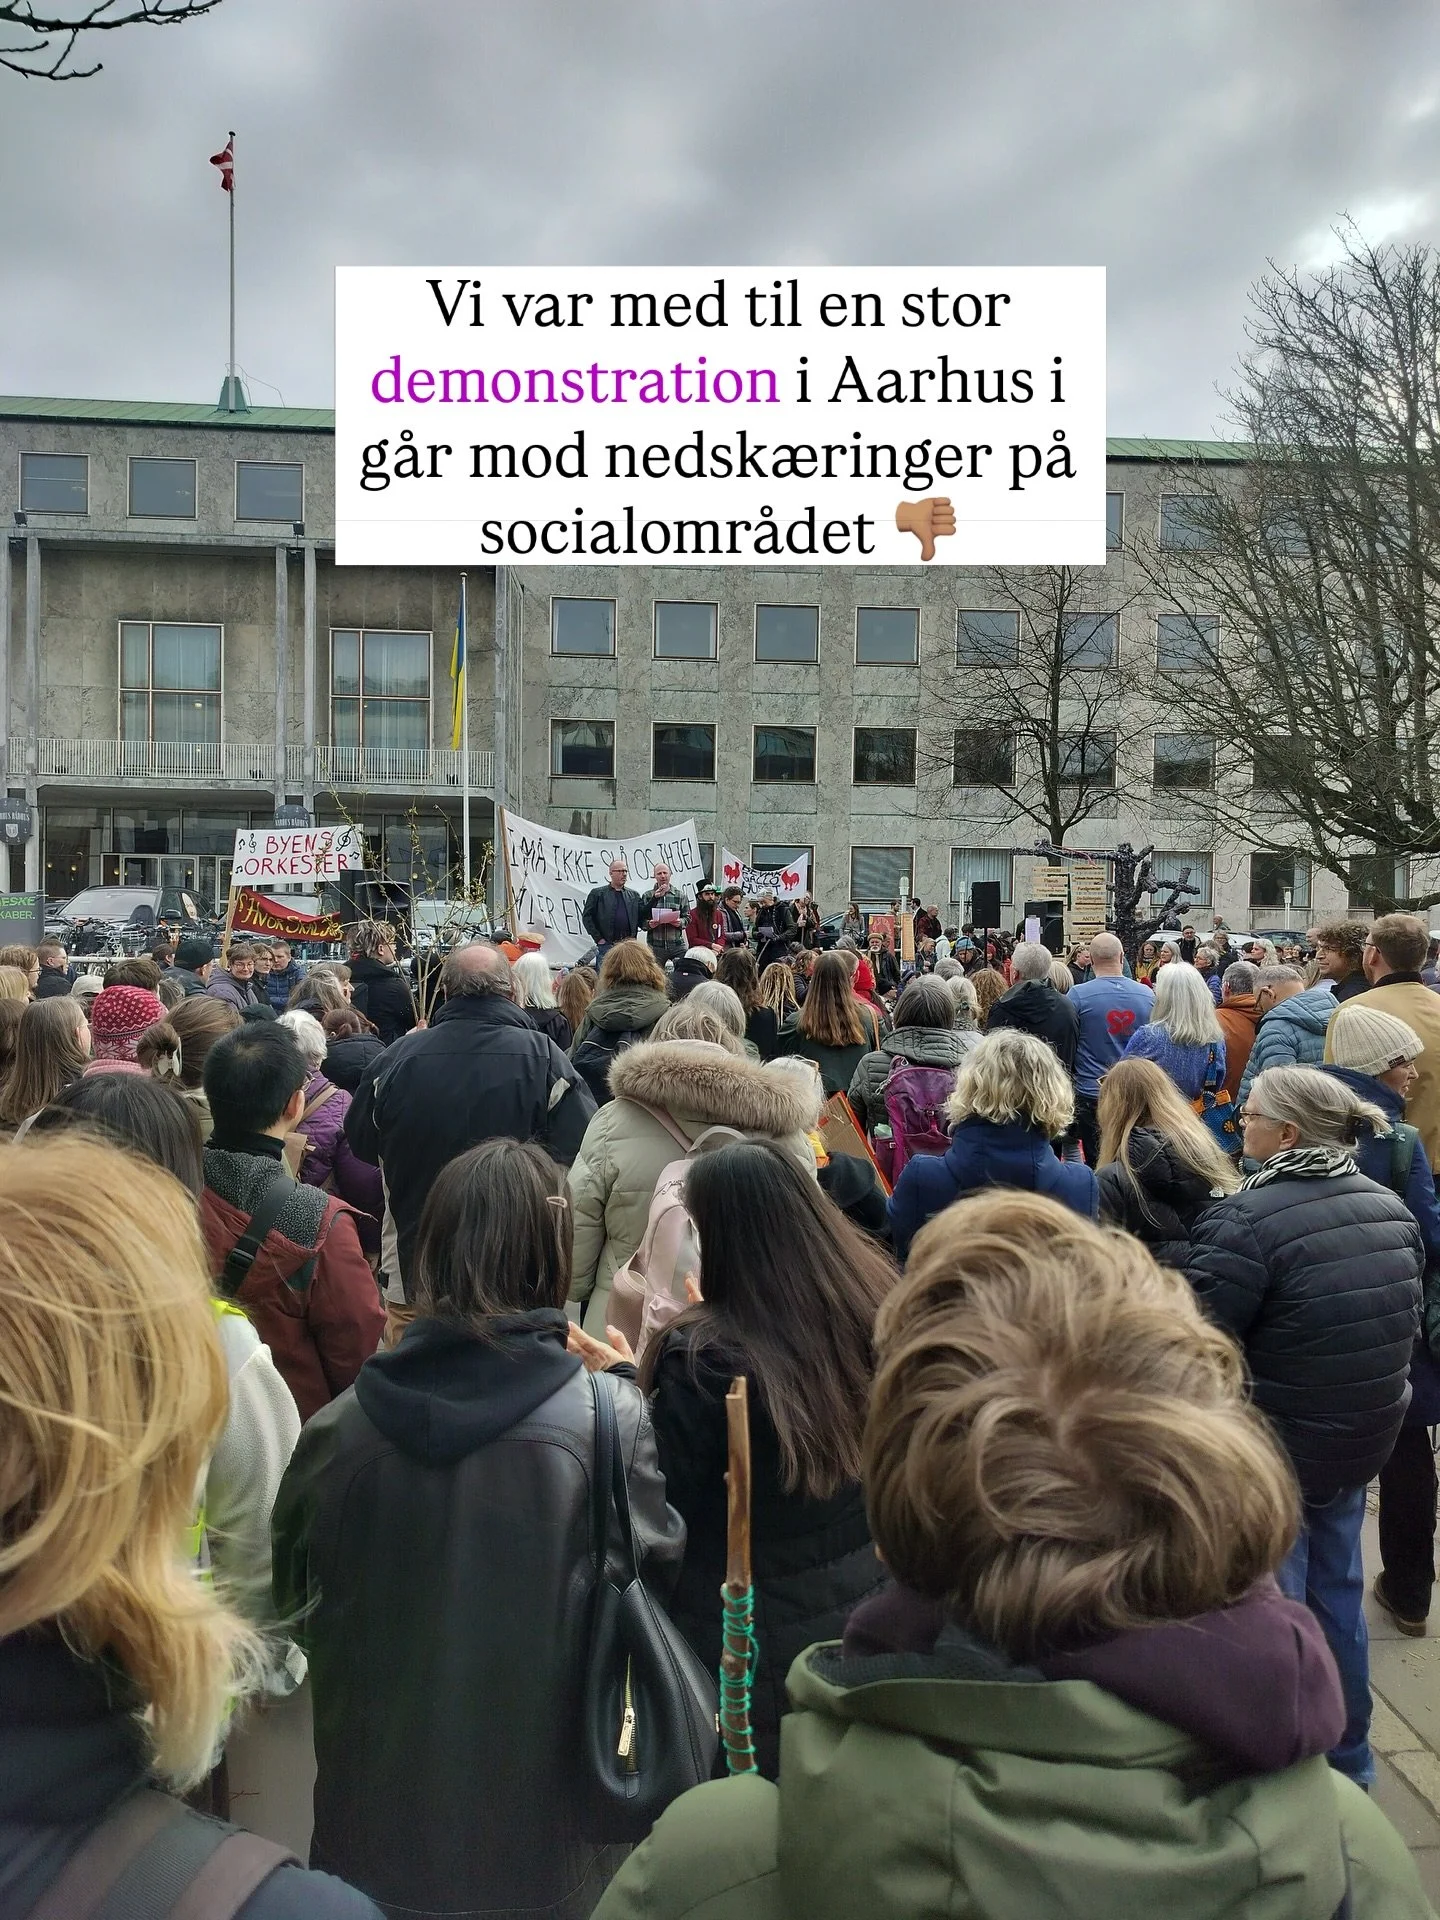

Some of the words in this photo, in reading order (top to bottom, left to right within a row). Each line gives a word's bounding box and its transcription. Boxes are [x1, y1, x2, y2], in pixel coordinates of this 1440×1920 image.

[266, 832, 333, 855] BYENS
[244, 854, 349, 876] ORKESTER
[520, 836, 546, 874] MÅ
[552, 845, 598, 884] IKKE
[633, 848, 656, 880] OS
[657, 837, 701, 874] IHJEL
[0, 897, 36, 907] ESKE
[241, 898, 284, 930] HVOR
[285, 915, 320, 936] SKAL
[511, 887, 534, 924] VI
[537, 895, 561, 933] ER
